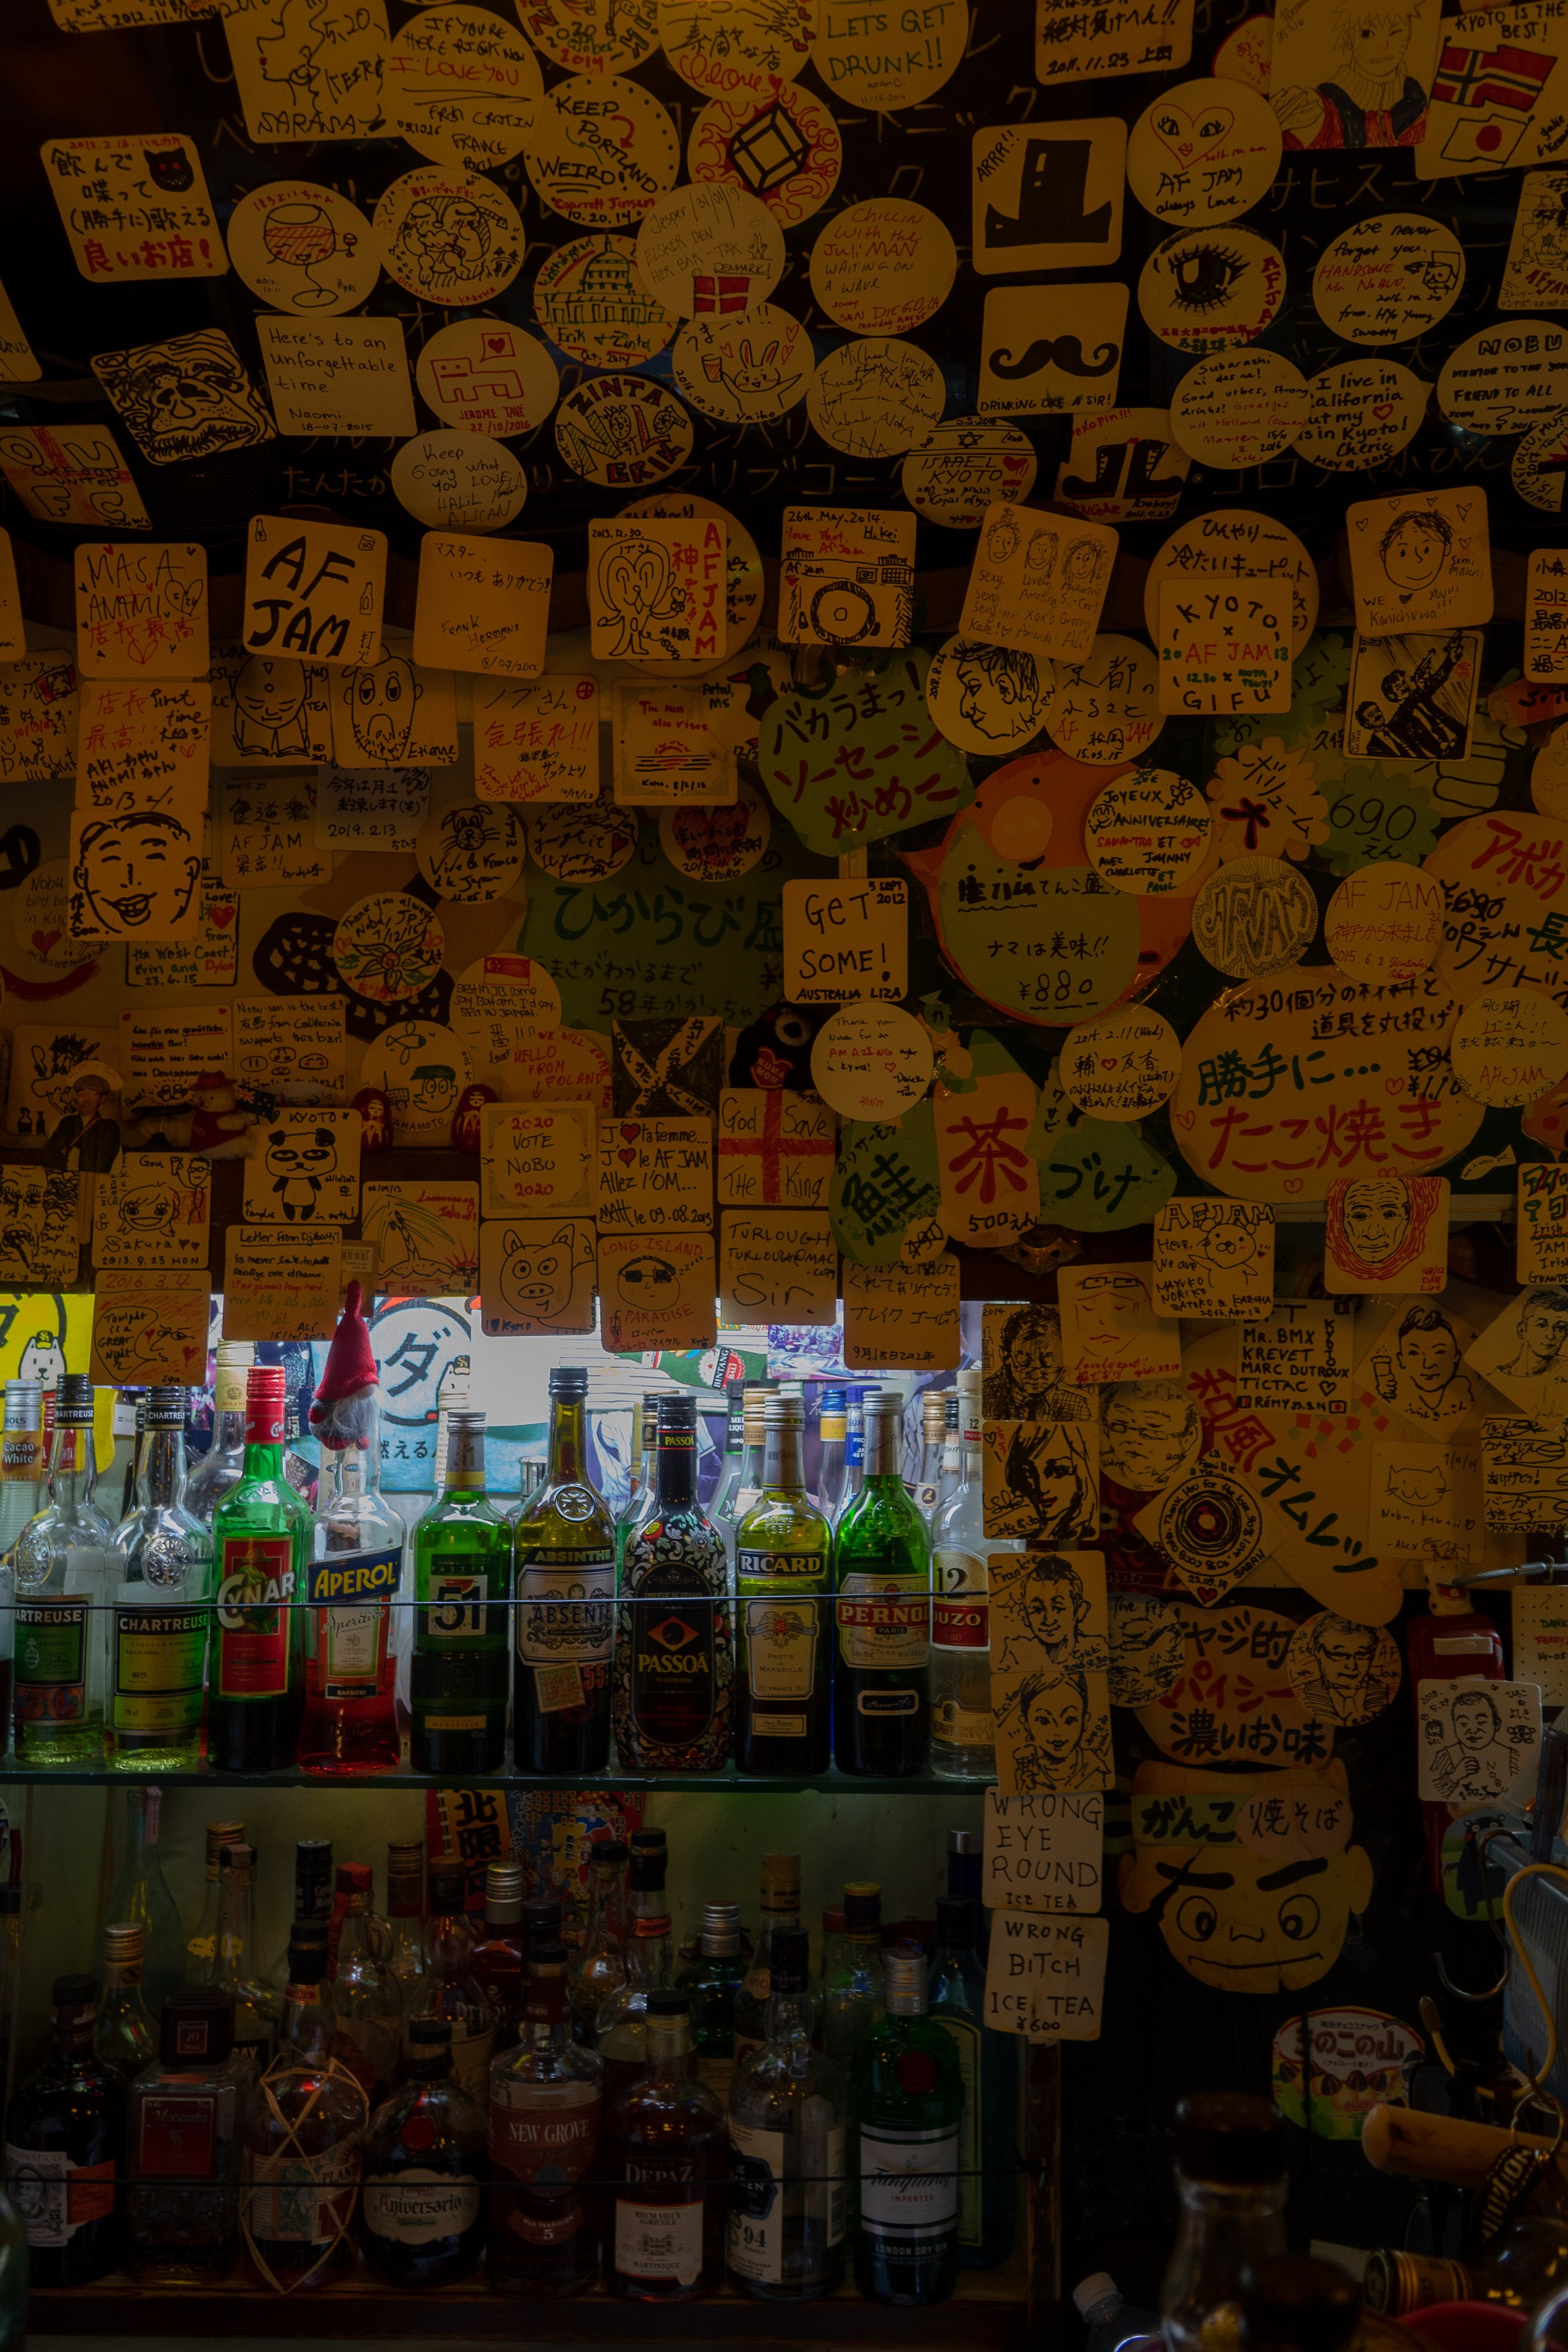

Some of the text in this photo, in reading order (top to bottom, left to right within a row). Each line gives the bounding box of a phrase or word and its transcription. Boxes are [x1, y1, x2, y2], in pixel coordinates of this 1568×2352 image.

[827, 2, 954, 38] LETS GET
[1456, 3, 1566, 34] KYOTO IS THE
[1502, 23, 1548, 41] BEST!
[829, 41, 943, 82] DRUNK!!
[556, 95, 619, 117] KEEP
[51, 151, 132, 176] 飲んで
[579, 120, 657, 193] PORTLAND
[975, 130, 1021, 181] ARRR!!
[538, 157, 628, 191] WEIRD!
[1156, 166, 1242, 196] AF JAM
[82, 181, 152, 201] 喋って
[1156, 196, 1195, 215] always
[70, 207, 211, 236] (勝手に)歌える
[84, 234, 215, 273] 良いお店!
[713, 263, 771, 274] DENMARK!
[1318, 264, 1393, 278] HANDSOME
[269, 329, 386, 351] Here's to an
[557, 327, 586, 344] Erik
[1478, 336, 1563, 355] NOBU
[271, 354, 396, 373] unforgettable
[275, 378, 329, 393] time
[1340, 374, 1374, 388] live
[1380, 372, 1397, 384] in
[570, 379, 661, 412] ZINTA
[1505, 388, 1520, 398] TO
[1526, 384, 1554, 397] ALL
[289, 408, 341, 420] Naomi
[458, 408, 498, 420] JEROME
[302, 421, 373, 432] 18-07-2015
[470, 420, 531, 432] 22/10/2016
[423, 443, 464, 462] Keep
[921, 456, 997, 470] ISRAEL
[930, 470, 1002, 484] KYOTO
[87, 551, 185, 586] MASA
[261, 536, 356, 601] AF
[450, 570, 484, 584] いつも
[1363, 596, 1385, 606] WE
[1176, 595, 1277, 629] KYOTO
[88, 615, 196, 645] 店長最高
[248, 599, 351, 657] JAM
[1185, 642, 1271, 664] AF JAM
[481, 656, 538, 672] 18/07/2012
[774, 661, 924, 753] バカうまっ!
[1183, 689, 1271, 711] GIFU
[1103, 790, 1163, 807] JOYEUX
[1329, 795, 1417, 842] 690
[231, 833, 302, 852] AF JAM
[1362, 842, 1402, 860] えん
[1143, 851, 1190, 864] JOHNNY
[1333, 880, 1441, 912] AF JAM
[988, 933, 1110, 961] ナマは美味!!
[800, 944, 891, 981] SOME!
[797, 988, 861, 1000] AUSTRALIA
[514, 1049, 556, 1063] HELLO
[529, 1061, 565, 1074] FROM
[756, 1066, 782, 1083] MON
[546, 1073, 603, 1086] POLAND
[290, 1112, 336, 1124] KYOTO
[511, 1117, 554, 1130] 2020
[723, 1098, 833, 1139] God Save
[514, 1134, 554, 1148] VOTE
[1209, 1097, 1443, 1173] たこ焼き
[655, 1150, 708, 1171] AF JAM
[946, 1106, 1029, 1204] 茶
[507, 1157, 555, 1174] NOBU
[514, 1183, 554, 1197] 2020
[600, 1172, 637, 1192] Allez
[785, 1167, 824, 1205] King
[841, 1152, 931, 1246] 鮭
[102, 1236, 173, 1253] Sakura
[601, 1237, 702, 1256] LONG ISLAND
[171, 1256, 199, 1265] MON
[1277, 1330, 1314, 1345] BMX
[1242, 1348, 1314, 1362] KREVET
[712, 1348, 729, 1389] BINTANG
[1241, 1362, 1349, 1377] MARC DUTROUX
[4, 1416, 27, 1424] BOLS
[55, 1409, 93, 1419] CHARTREUSE
[1187, 1369, 1276, 1472] 和風
[3, 1443, 34, 1454] Cacao
[3, 1453, 34, 1464] White
[535, 1549, 610, 1562] ABSINTHE
[740, 1555, 821, 1572] RICARD
[315, 1564, 396, 1598] APEROL
[938, 1567, 968, 1599] 12
[218, 1570, 297, 1629] CYNAR
[434, 1585, 480, 1630] 51
[119, 1614, 208, 1631] CHARTREUSE
[532, 1606, 612, 1624] ABSENTE
[768, 1653, 794, 1661] PASTIS
[1172, 1708, 1325, 1764] 濃いお味
[992, 1793, 1102, 1830] WRONG
[1142, 1796, 1236, 1842] がんこ
[1249, 1796, 1343, 1838] 焼そば
[997, 1826, 1051, 1851] EYE
[992, 1856, 1098, 1887] ROUND
[1045, 1894, 1078, 1909] TEA
[1005, 1920, 1084, 1947] WRONG
[991, 1993, 1094, 2016] ICE TEA
[507, 2119, 589, 2143] NEW GROVE
[874, 2243, 906, 2255] LONDON
